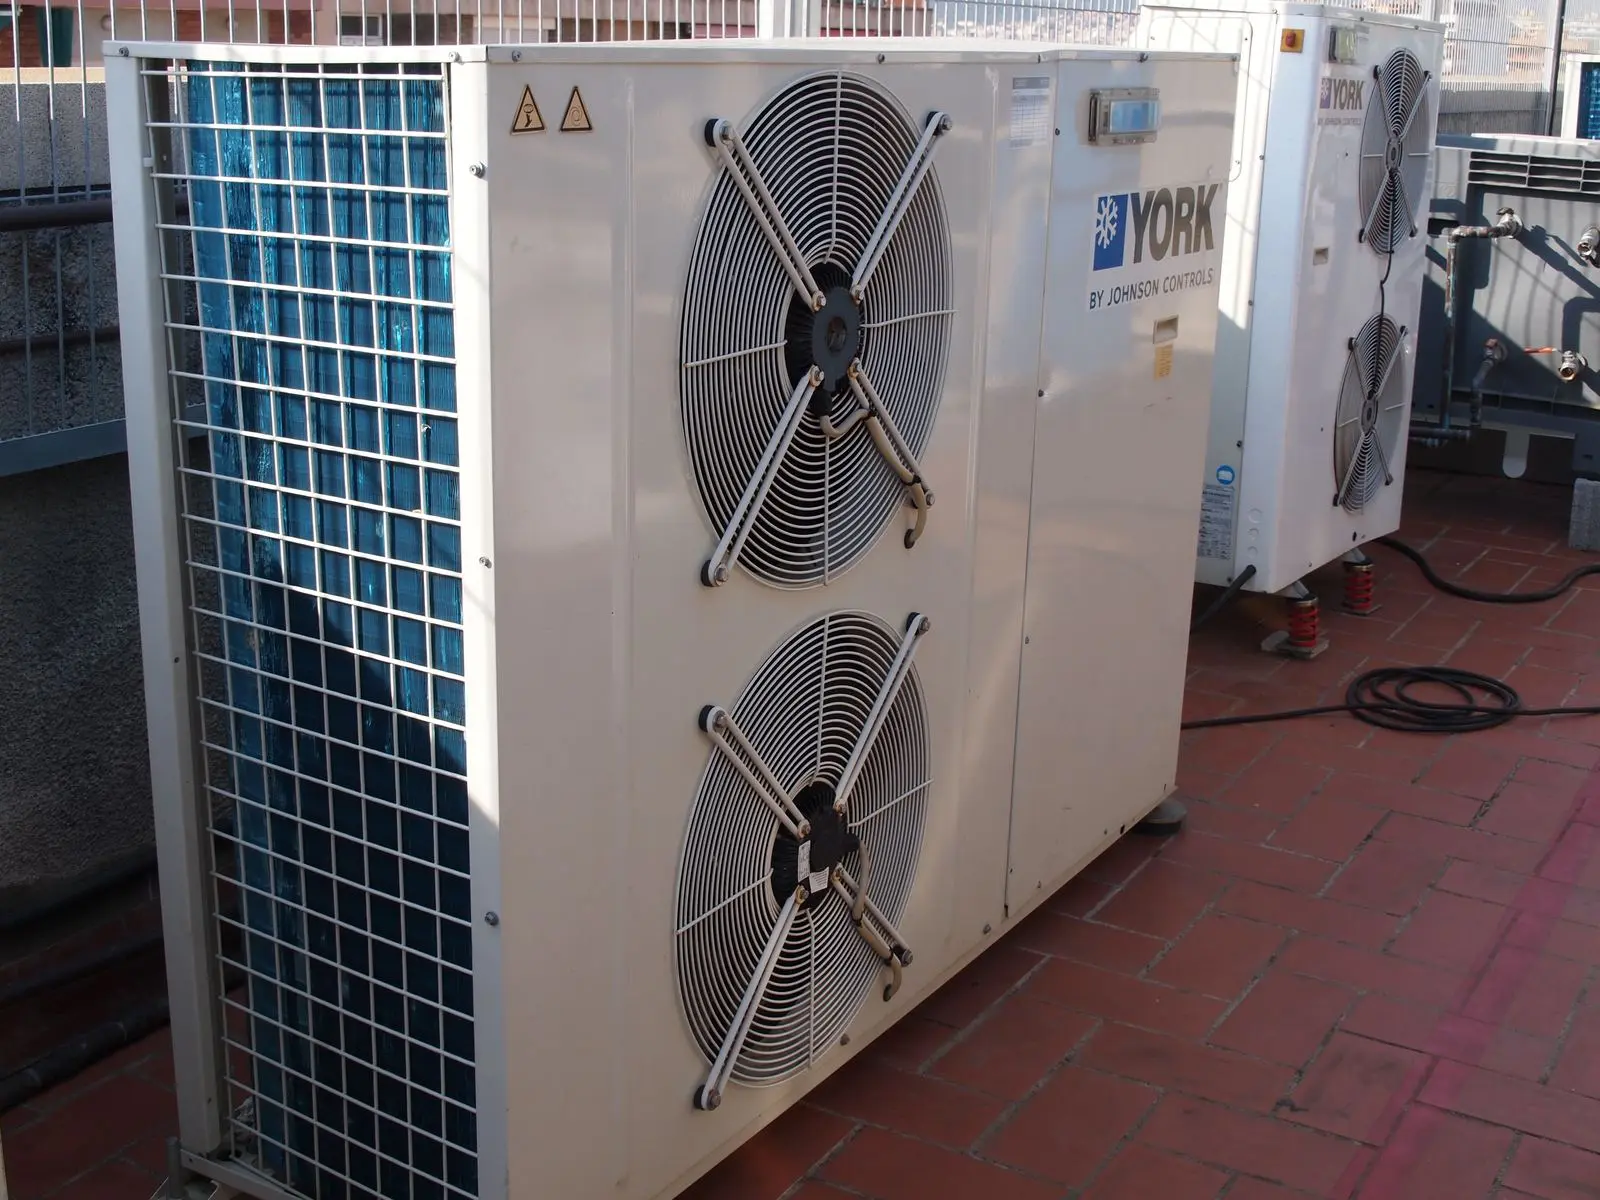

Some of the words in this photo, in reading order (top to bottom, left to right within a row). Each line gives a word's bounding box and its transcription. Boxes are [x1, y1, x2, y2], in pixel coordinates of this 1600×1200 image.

[1333, 79, 1365, 110] YORK
[1130, 183, 1219, 264] YORK
[1089, 290, 1104, 310] BY
[1107, 279, 1159, 306] JOHNSON
[1163, 268, 1214, 294] CONTROLS
